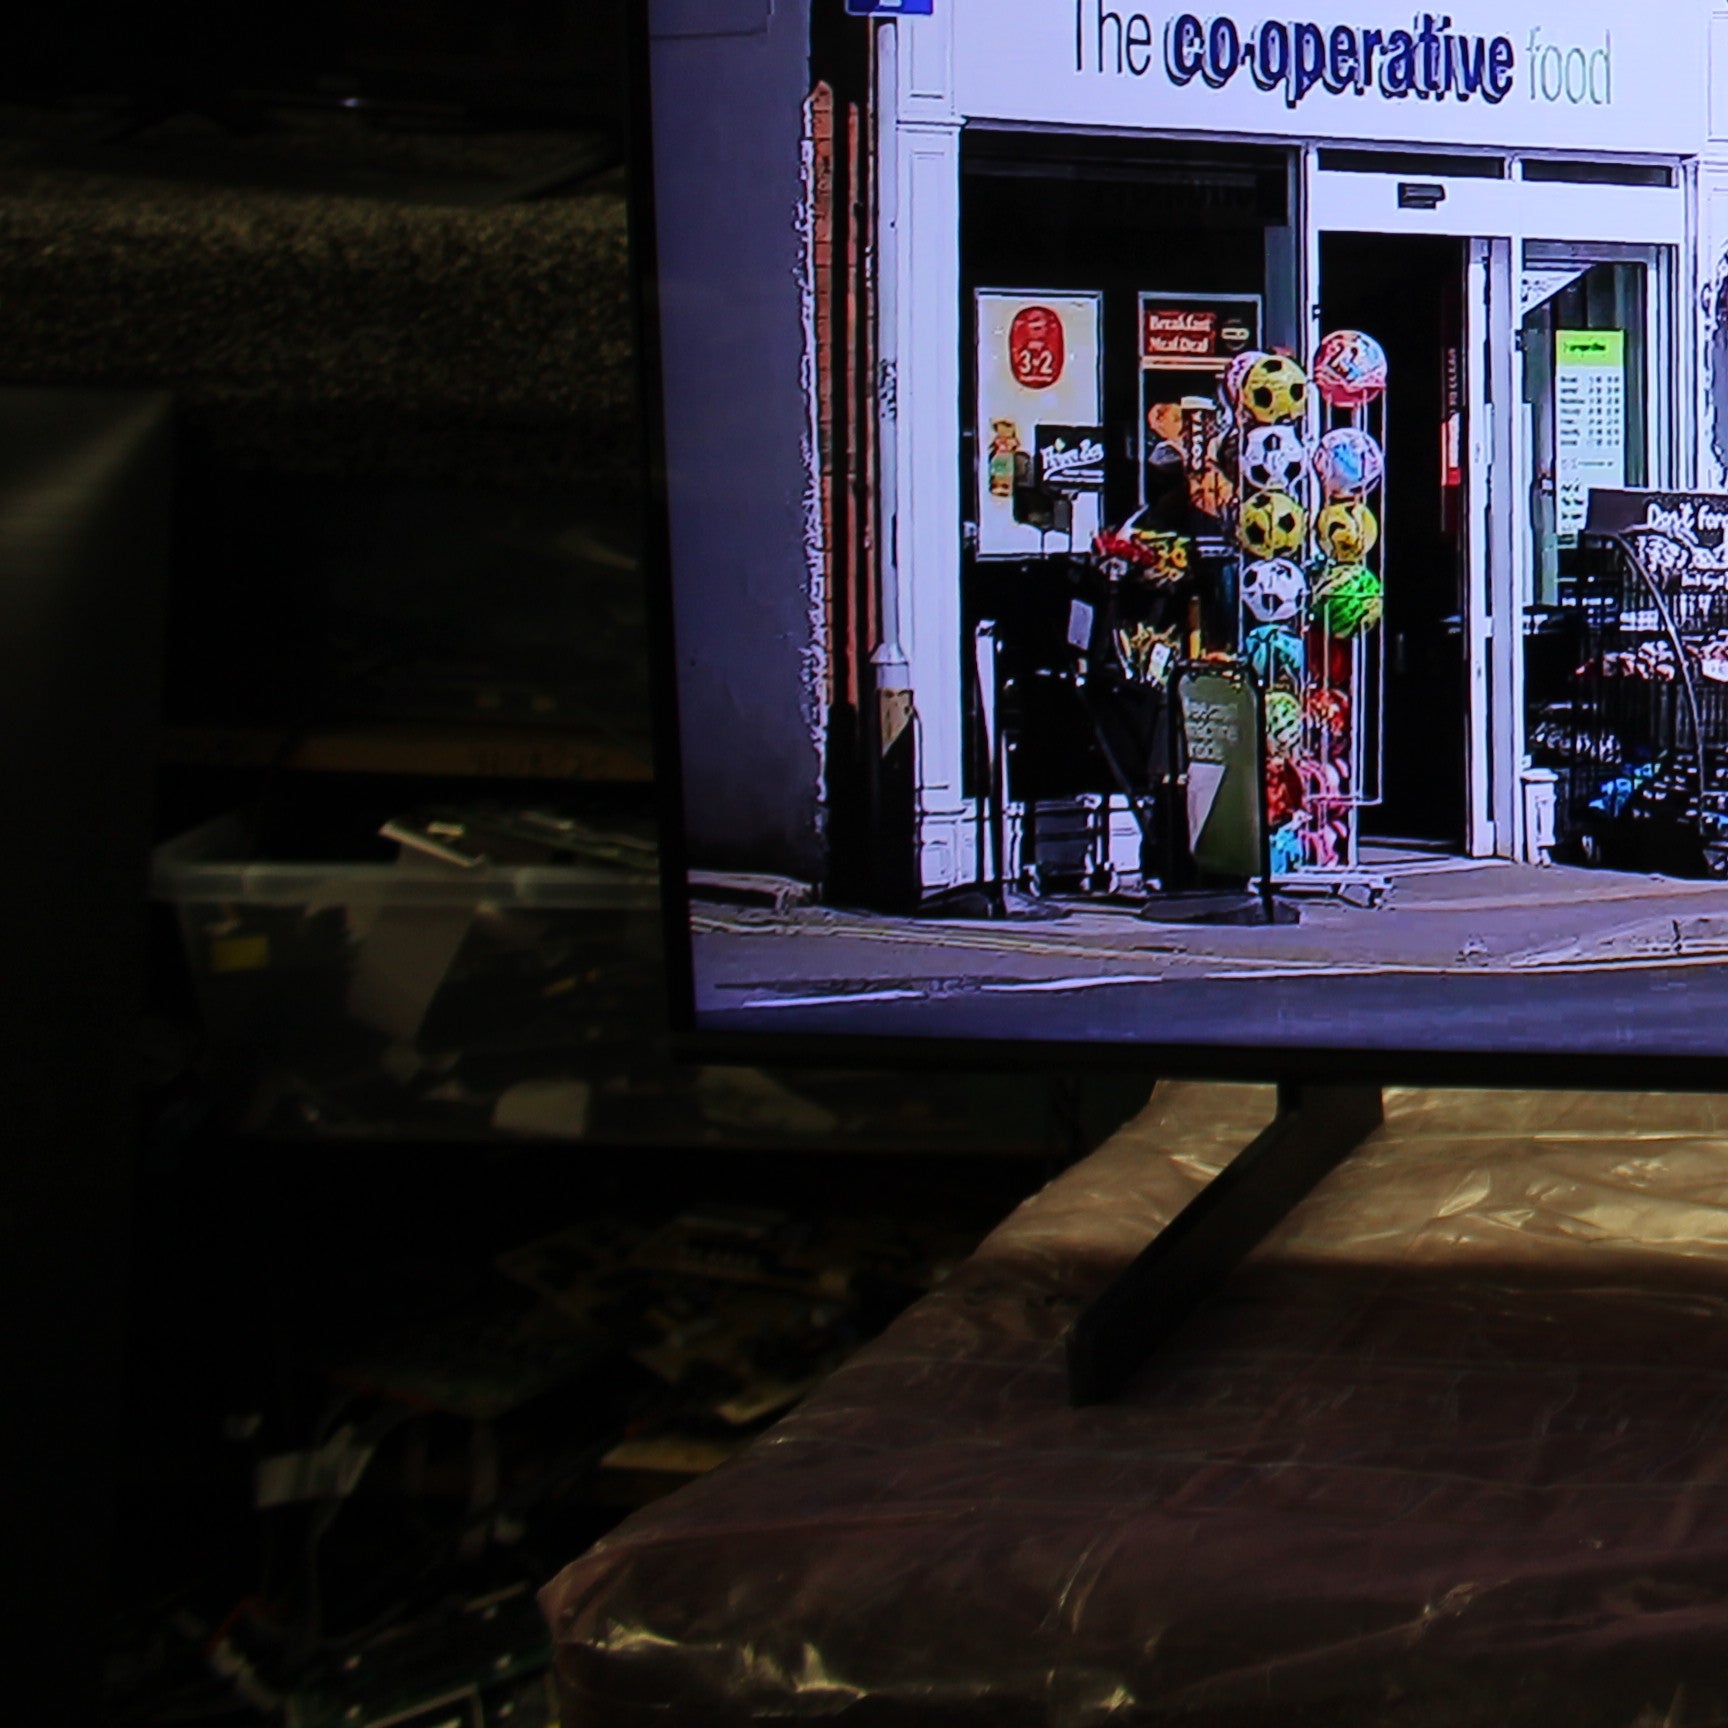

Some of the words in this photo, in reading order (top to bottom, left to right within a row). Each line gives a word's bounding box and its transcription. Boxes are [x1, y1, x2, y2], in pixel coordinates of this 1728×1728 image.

[1165, 10, 1515, 109] co-operative
[1525, 25, 1612, 106] food
[1150, 313, 1211, 331] Breakfast
[1150, 335, 1179, 352] Meal
[1180, 336, 1209, 353] Deal
